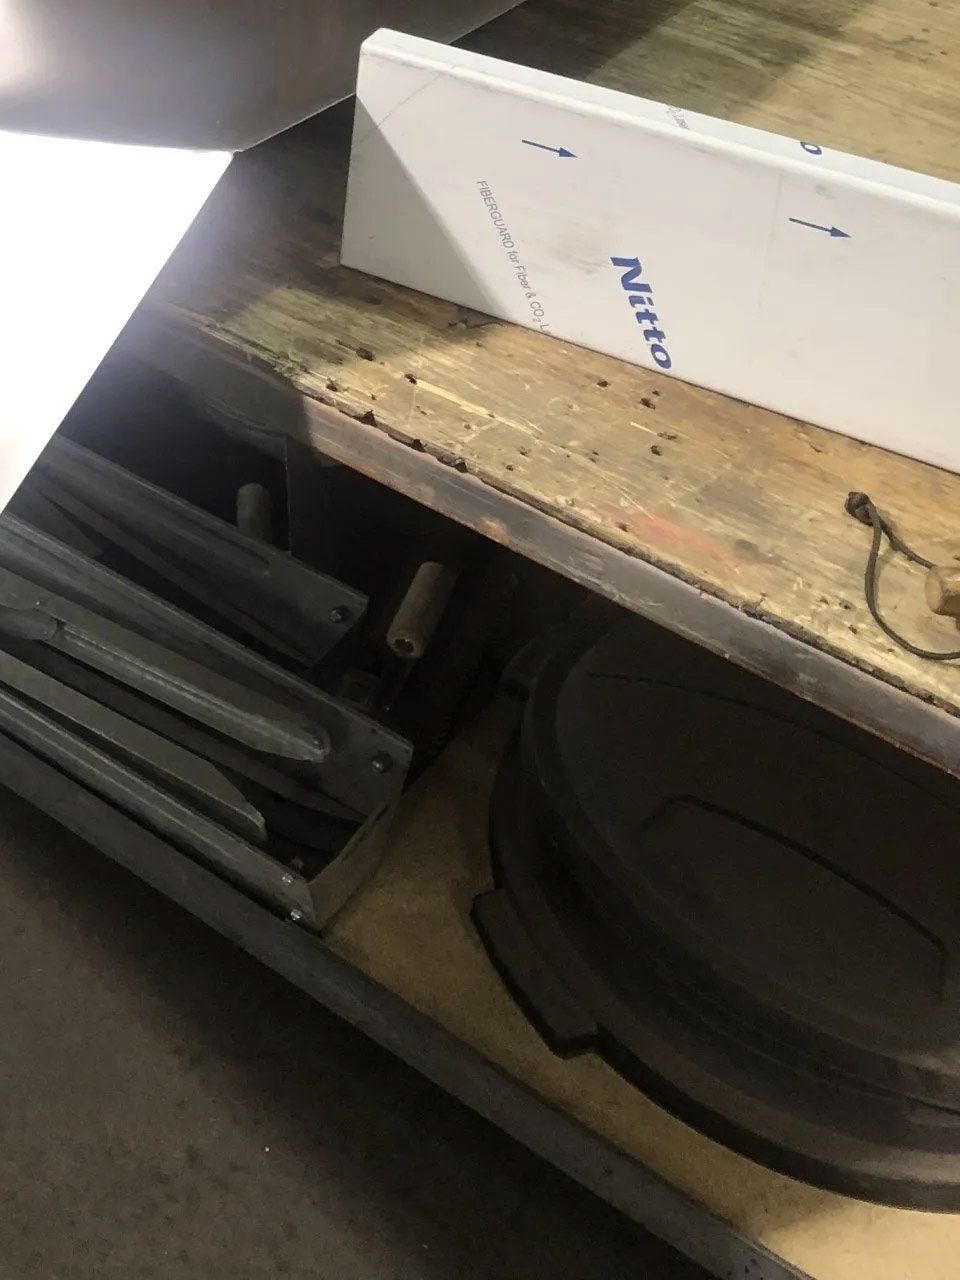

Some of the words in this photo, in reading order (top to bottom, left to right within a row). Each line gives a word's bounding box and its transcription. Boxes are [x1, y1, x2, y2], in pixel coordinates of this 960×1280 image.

[476, 180, 515, 249] FIBERGUARD
[507, 250, 520, 267] for
[514, 265, 532, 290] Fiber
[610, 256, 672, 369] Nitto
